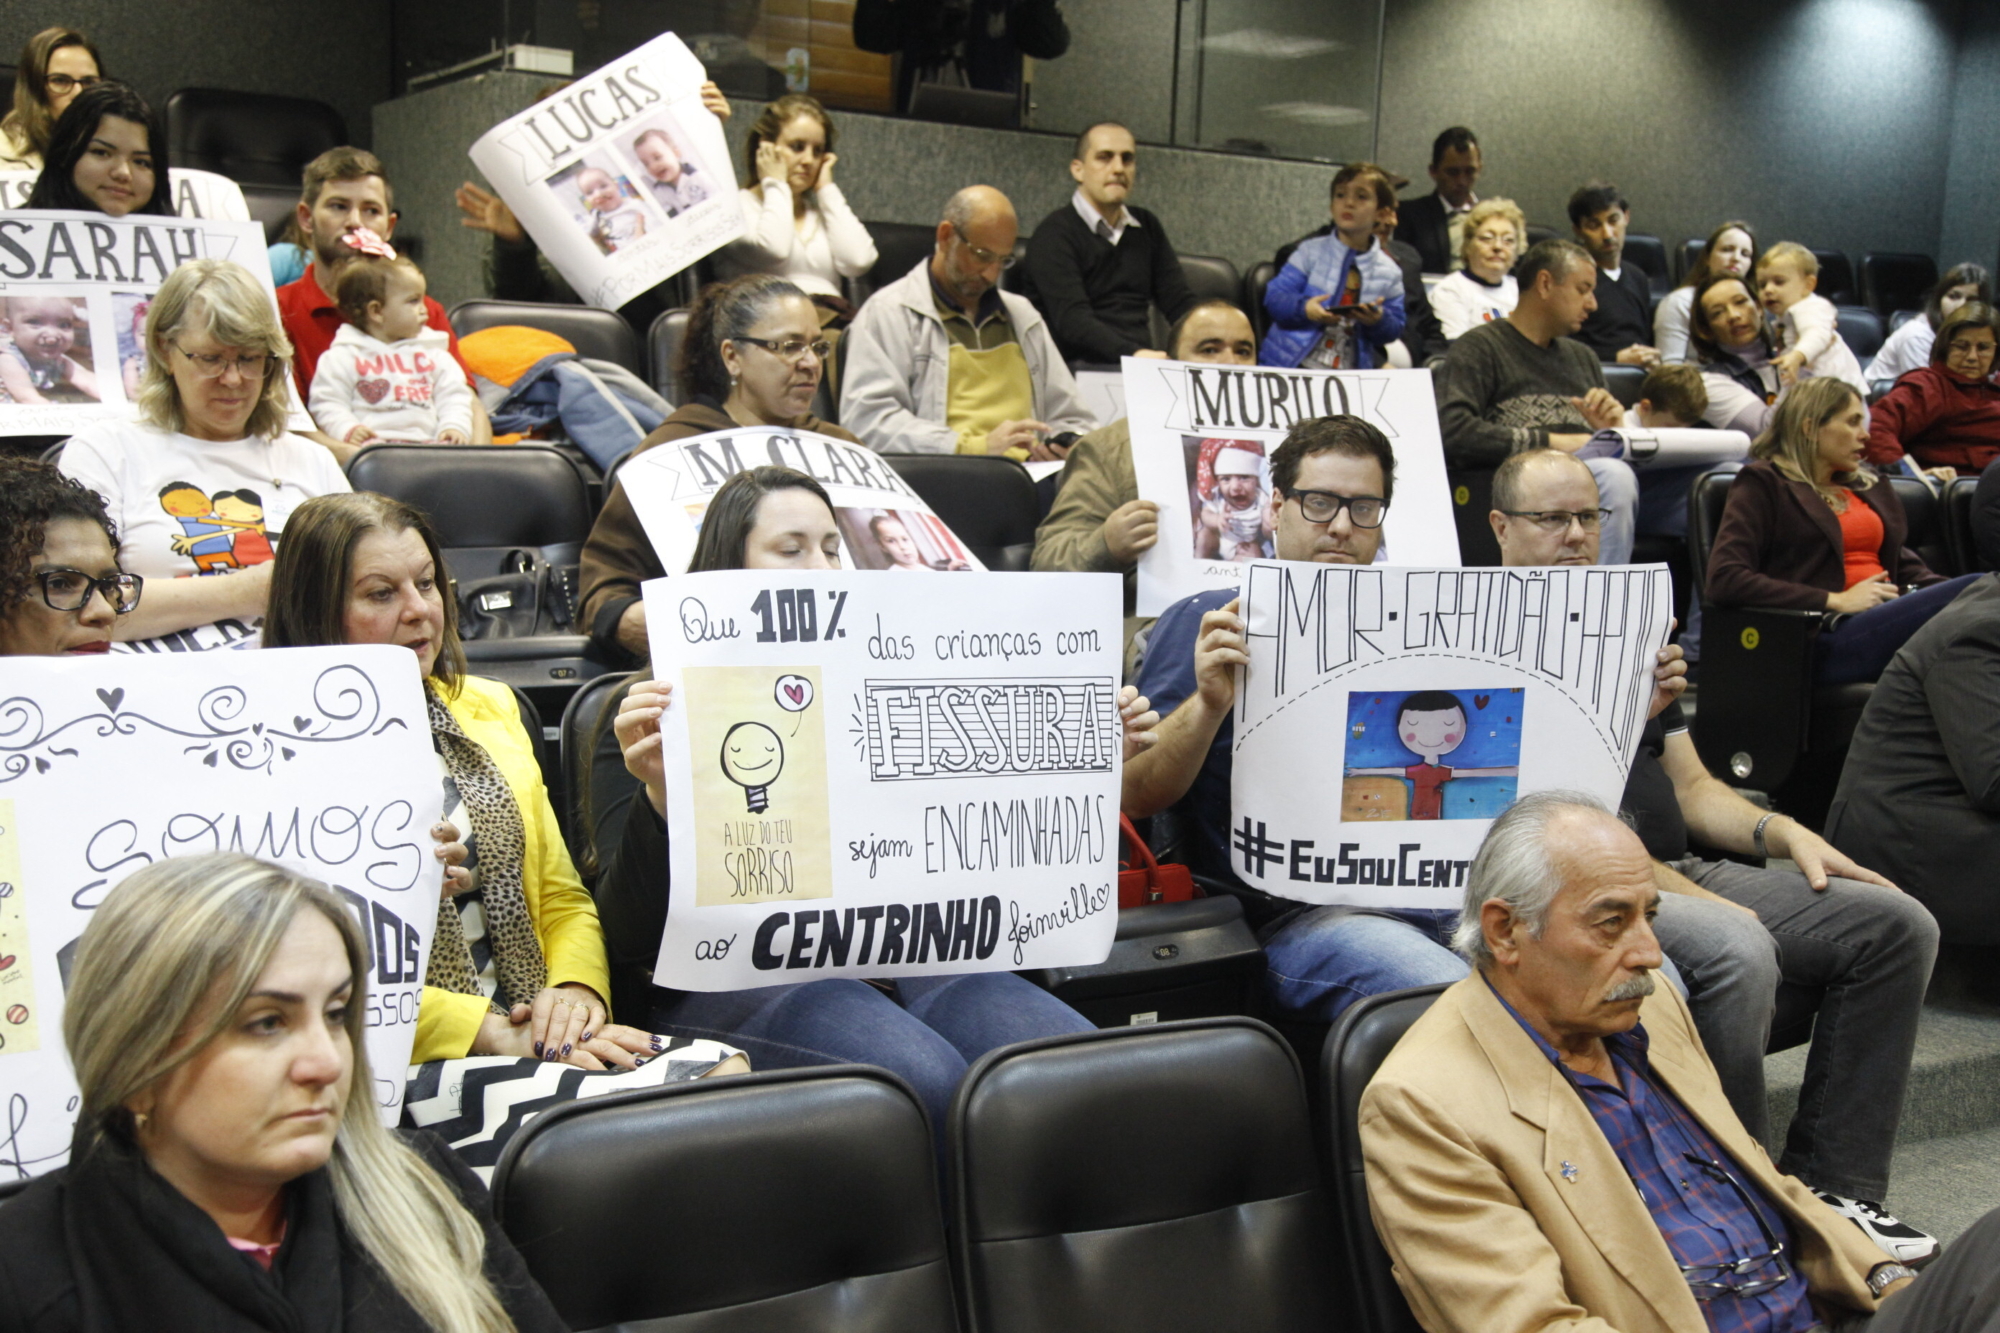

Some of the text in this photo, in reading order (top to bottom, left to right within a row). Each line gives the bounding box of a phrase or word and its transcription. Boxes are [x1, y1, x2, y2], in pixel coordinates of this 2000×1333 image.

[524, 66, 661, 161] LUCAS
[0, 220, 198, 283] SARAH
[1189, 369, 1350, 429] MURILO
[766, 435, 917, 498] CLARA
[1203, 566, 1242, 578] ant
[679, 588, 1101, 661] Que 100% das crianças com
[1241, 564, 1384, 723] AMOR
[1403, 570, 1570, 680] GRATIDÃO
[872, 683, 1109, 778] FISSURA
[724, 819, 793, 847] A LUZ DO TEU
[849, 795, 1105, 878] sejam ENCAMINHADAS
[725, 847, 794, 898] SORRISO
[695, 934, 737, 961] ao
[751, 895, 1001, 971] CENTRINHO
